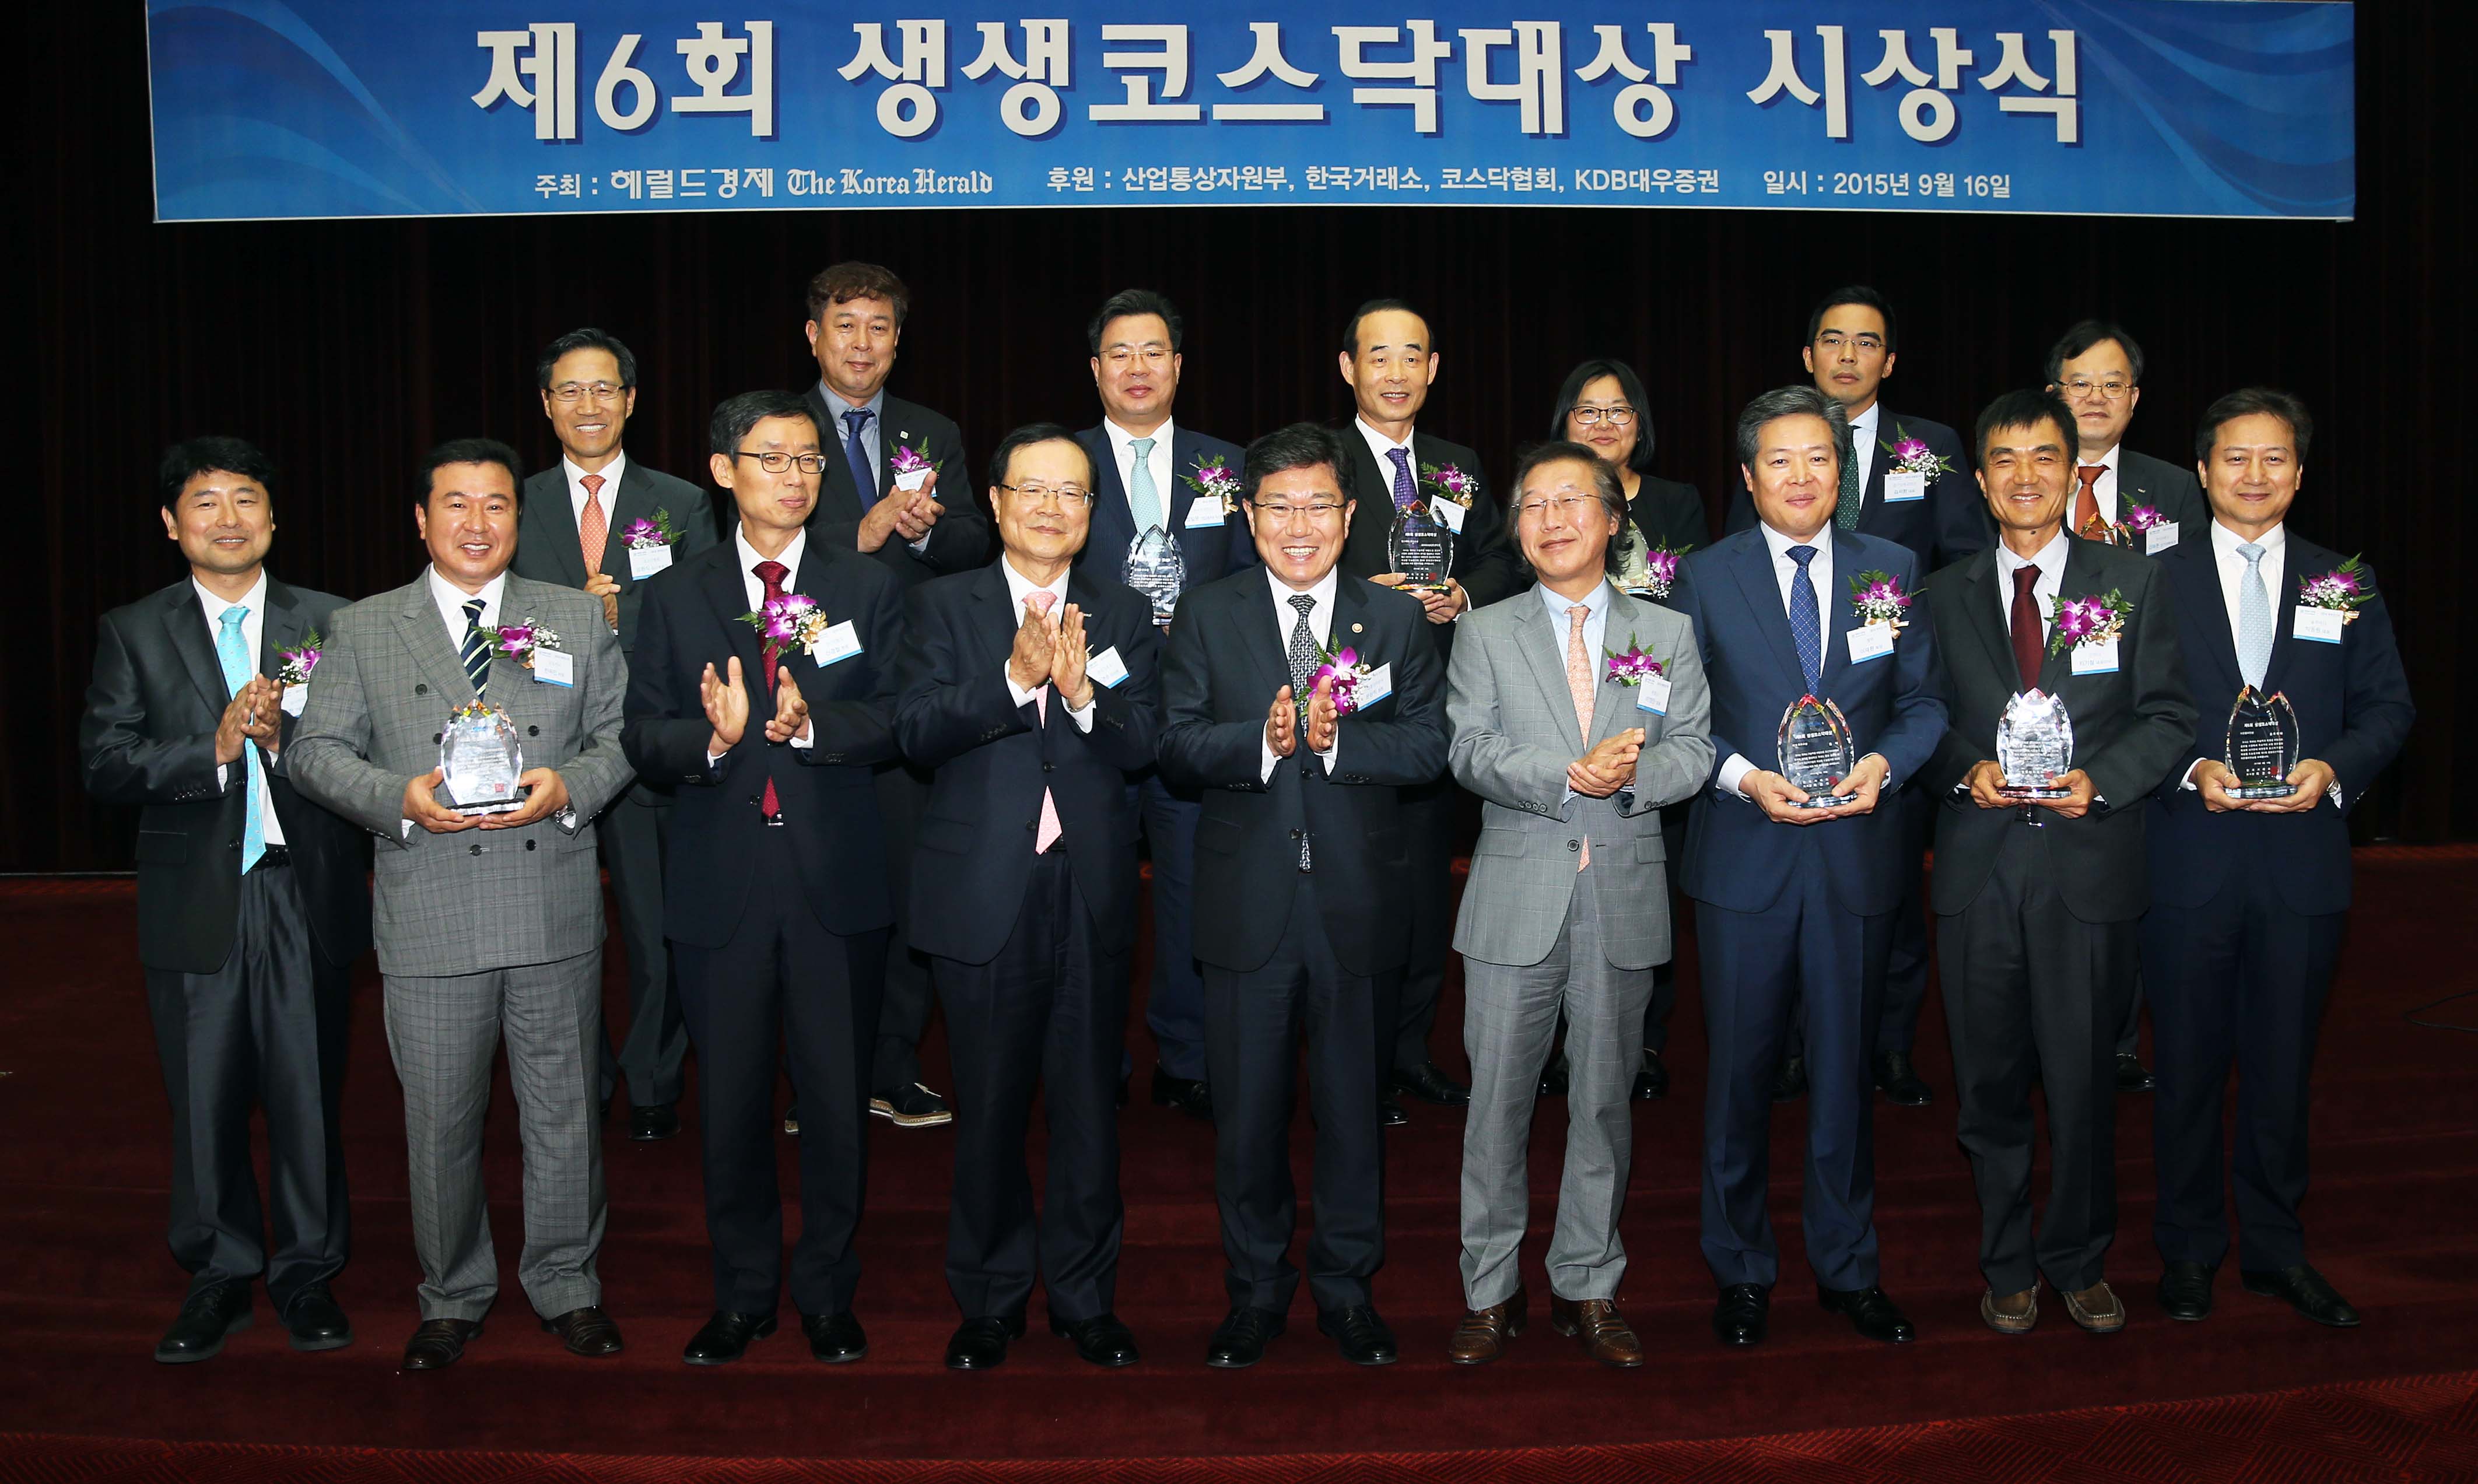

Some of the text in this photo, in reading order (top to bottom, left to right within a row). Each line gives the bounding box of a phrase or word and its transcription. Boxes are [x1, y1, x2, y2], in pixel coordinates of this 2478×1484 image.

[471, 19, 2077, 143] 제6회 생생코스닥대상 시상식
[535, 174, 580, 199] 주최
[611, 168, 774, 199] 헤럴드경제
[787, 169, 836, 196] The
[840, 168, 910, 195] Korea
[912, 167, 993, 195] Herald
[1047, 167, 1095, 192] 후원
[1122, 166, 1295, 192] 산업통상자원부,
[1305, 166, 1431, 192] 한국거래소,
[1440, 167, 1565, 194] 코스닥협회,
[1575, 168, 1719, 194] KDB대우증권
[1763, 170, 1807, 195] 일시
[1834, 172, 1909, 197] 2015년
[1919, 173, 1955, 197] 9월
[1964, 174, 2010, 198] 16일
